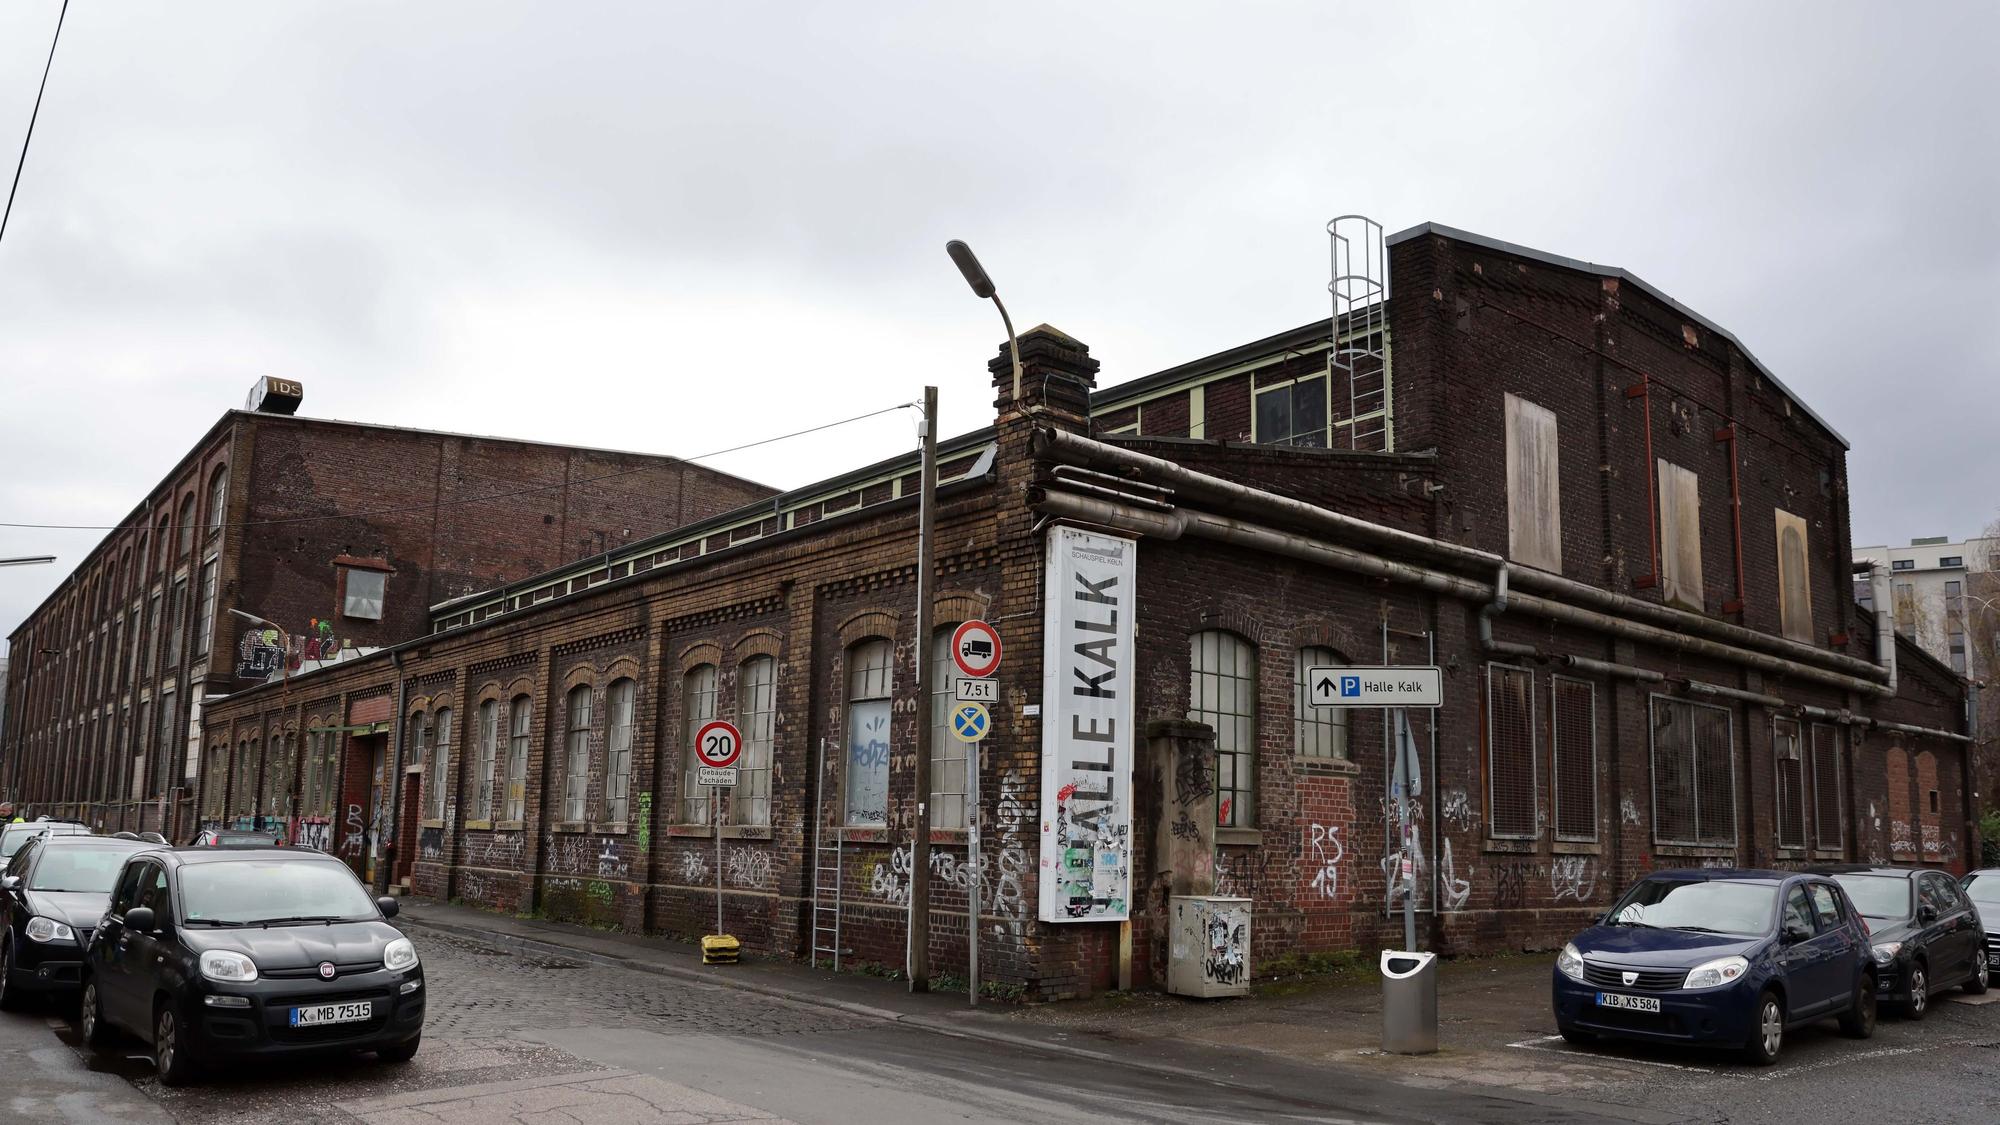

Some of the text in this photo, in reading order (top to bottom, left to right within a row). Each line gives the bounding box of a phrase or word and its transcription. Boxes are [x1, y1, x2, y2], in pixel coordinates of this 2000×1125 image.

[273, 381, 302, 397] IDS
[1072, 571, 1119, 698] KALK
[984, 683, 990, 697] t
[1364, 681, 1394, 693] Halle
[1398, 681, 1423, 693] Kalk
[706, 736, 731, 756] 20
[1311, 823, 1343, 864] RS
[1311, 865, 1338, 899] 19
[1602, 993, 1658, 1011] KIB XS 584
[299, 1008, 309, 1023] K
[317, 1006, 335, 1021] MB
[338, 1003, 370, 1019] 7515
